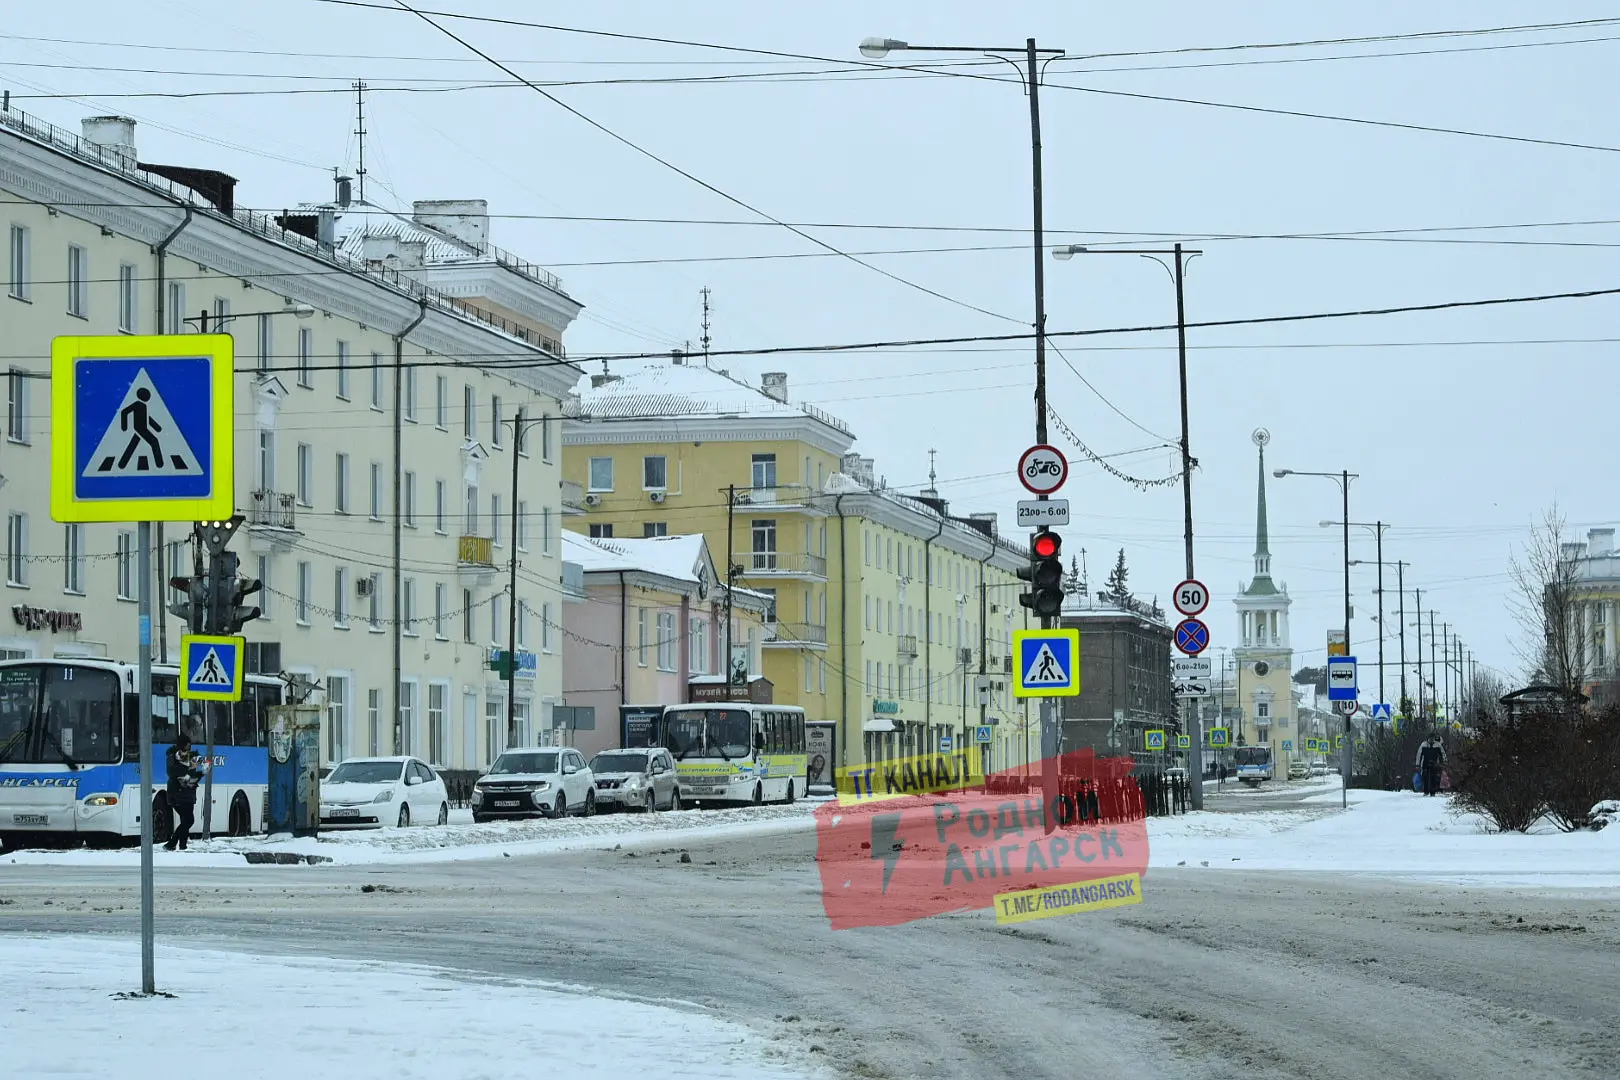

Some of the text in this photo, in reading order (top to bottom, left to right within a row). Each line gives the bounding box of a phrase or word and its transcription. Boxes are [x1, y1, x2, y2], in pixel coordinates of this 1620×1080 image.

[1181, 590, 1201, 606] 50
[63, 667, 73, 681] 11
[0, 778, 80, 788] НГАРСК
